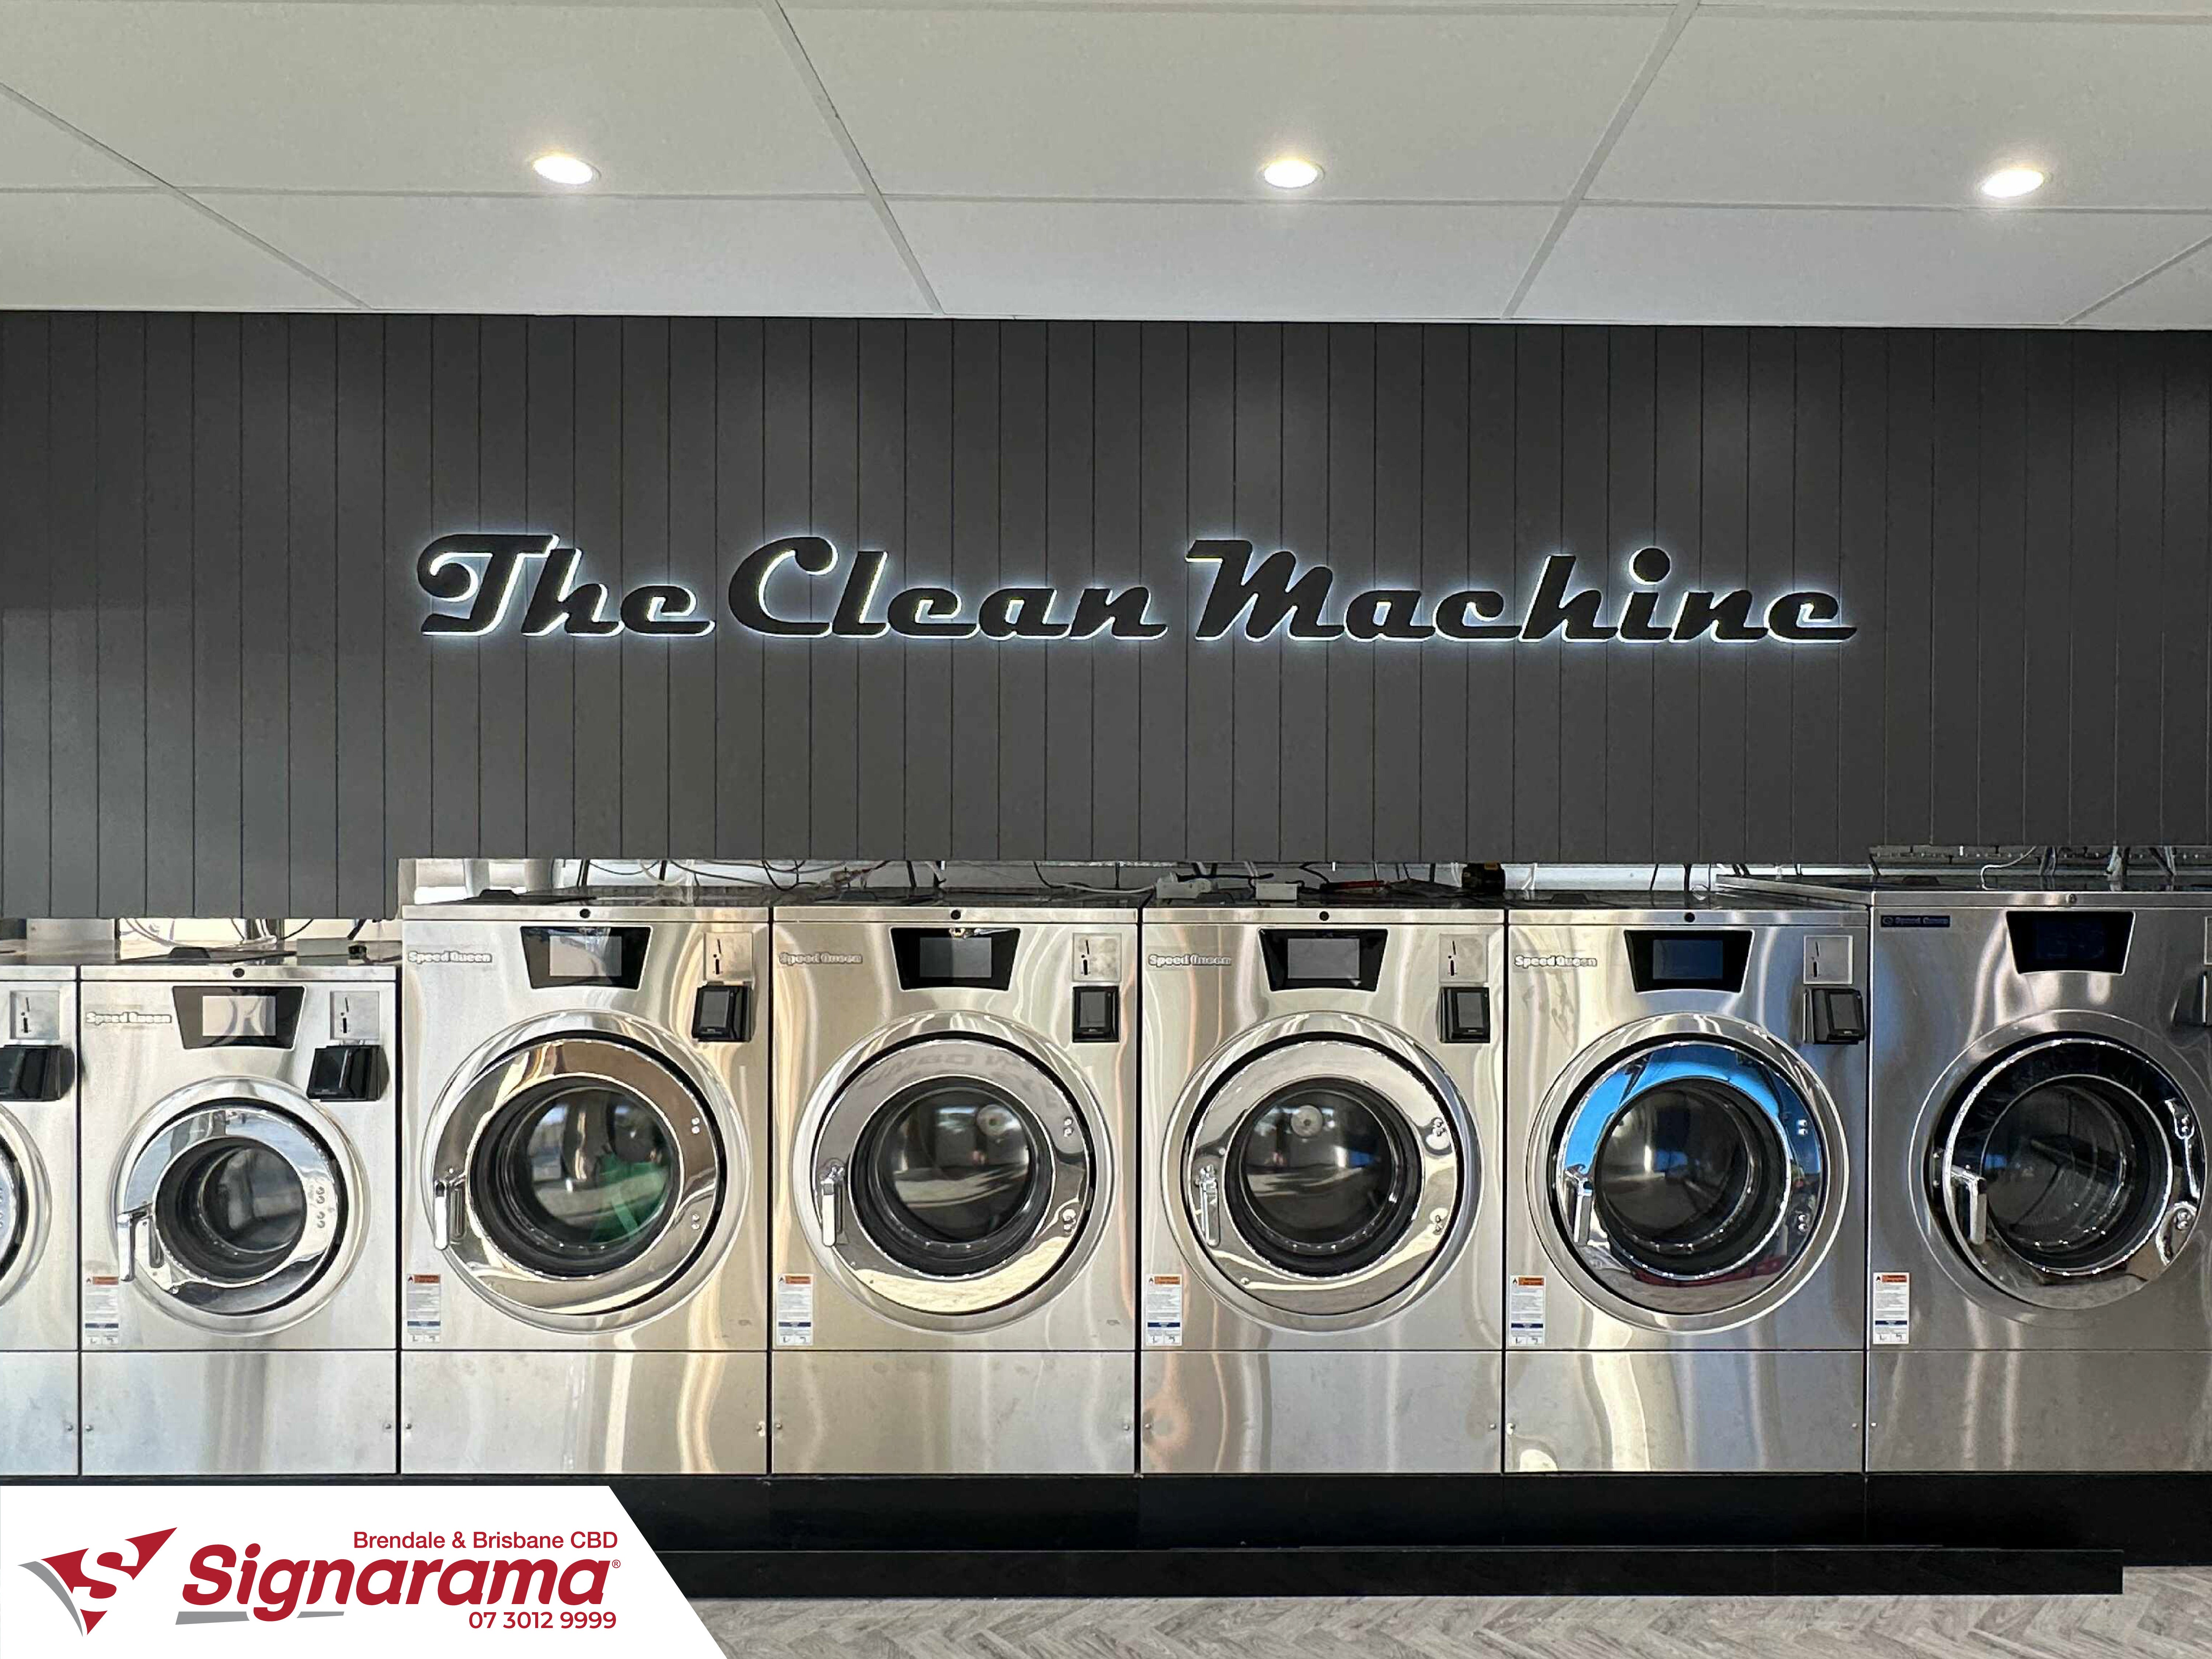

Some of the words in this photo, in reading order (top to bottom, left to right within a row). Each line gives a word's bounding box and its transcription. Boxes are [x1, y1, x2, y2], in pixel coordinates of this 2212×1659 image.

[417, 533, 716, 636] The
[728, 536, 1168, 640] Clean
[1184, 538, 1857, 643] Machine
[408, 950, 450, 964] Speed
[450, 951, 492, 963] Queen
[779, 952, 820, 966] Speed
[1148, 954, 1190, 967] Speed
[1514, 955, 1555, 969] Speed
[1556, 955, 1598, 967] Queen
[86, 1012, 128, 1025] Speed
